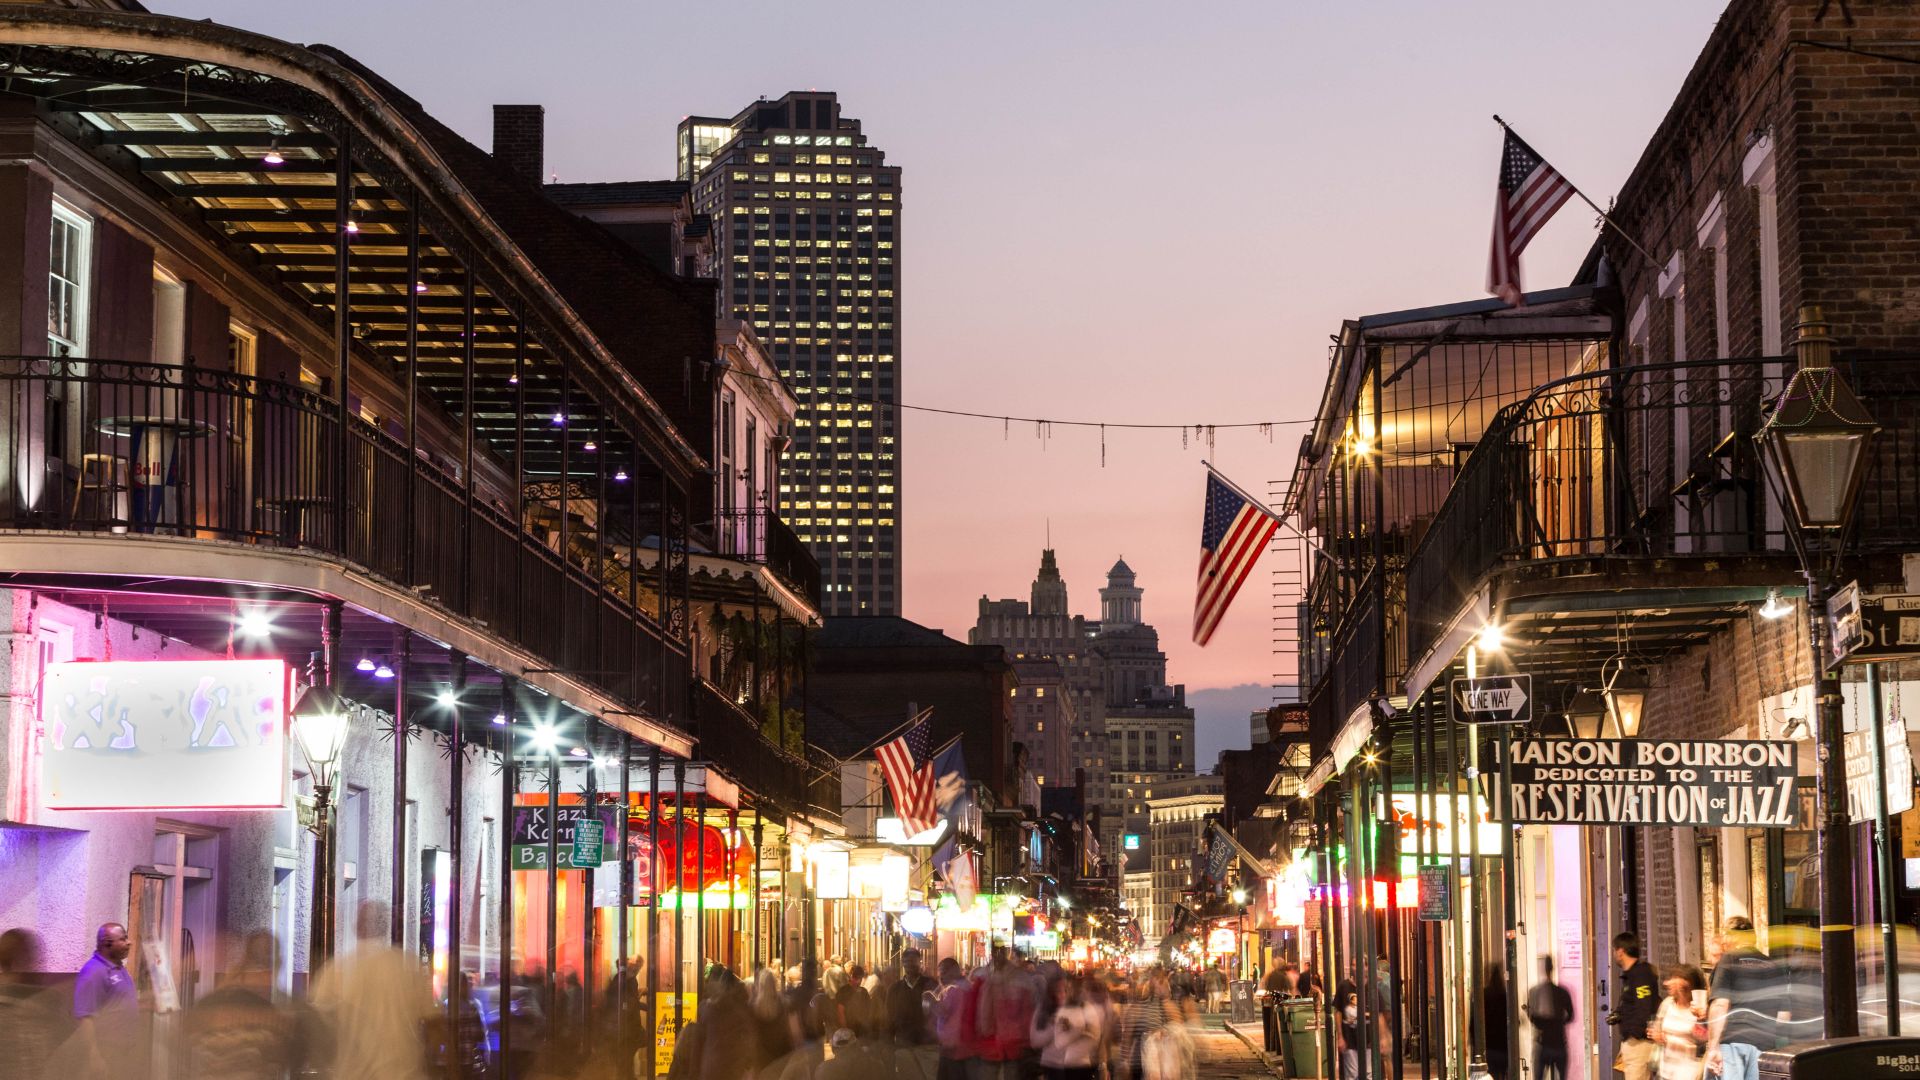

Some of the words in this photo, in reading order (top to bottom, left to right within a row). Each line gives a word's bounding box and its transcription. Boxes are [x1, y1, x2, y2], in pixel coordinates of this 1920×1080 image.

[1468, 692, 1488, 709] ONE
[1491, 690, 1510, 708] WAY
[1493, 740, 1621, 765] MAISON
[1637, 742, 1792, 767] BOURBON
[1534, 768, 1656, 782] DEDICATED
[1666, 769, 1697, 782] TO
[1710, 770, 1753, 783] THE
[1710, 798, 1726, 809] OF
[1722, 776, 1793, 825] JAZZ
